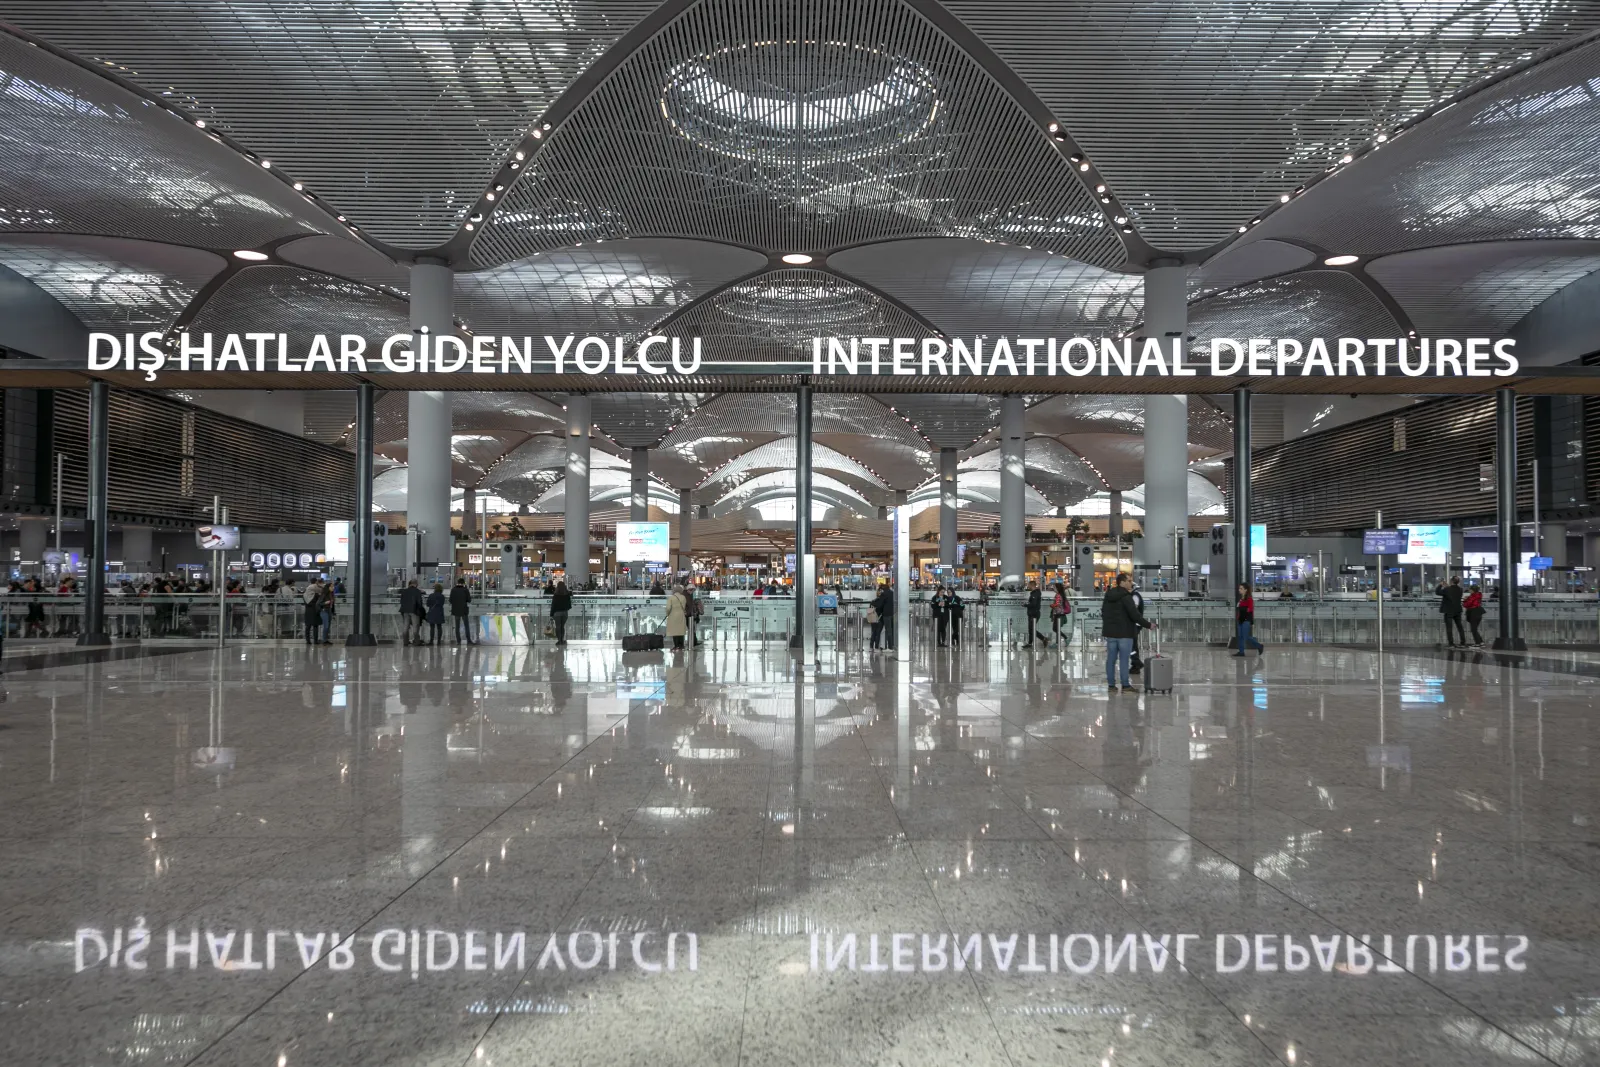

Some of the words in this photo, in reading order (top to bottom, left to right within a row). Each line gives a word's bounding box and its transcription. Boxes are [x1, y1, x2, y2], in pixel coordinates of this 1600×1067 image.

[87, 331, 165, 383] DIŞ
[178, 332, 367, 373] HATLAR
[382, 325, 532, 374] GİDEN
[543, 334, 702, 375] YOLCU
[811, 336, 1197, 377] INTERNATIONAL
[1210, 337, 1520, 378] DEPARTURES
